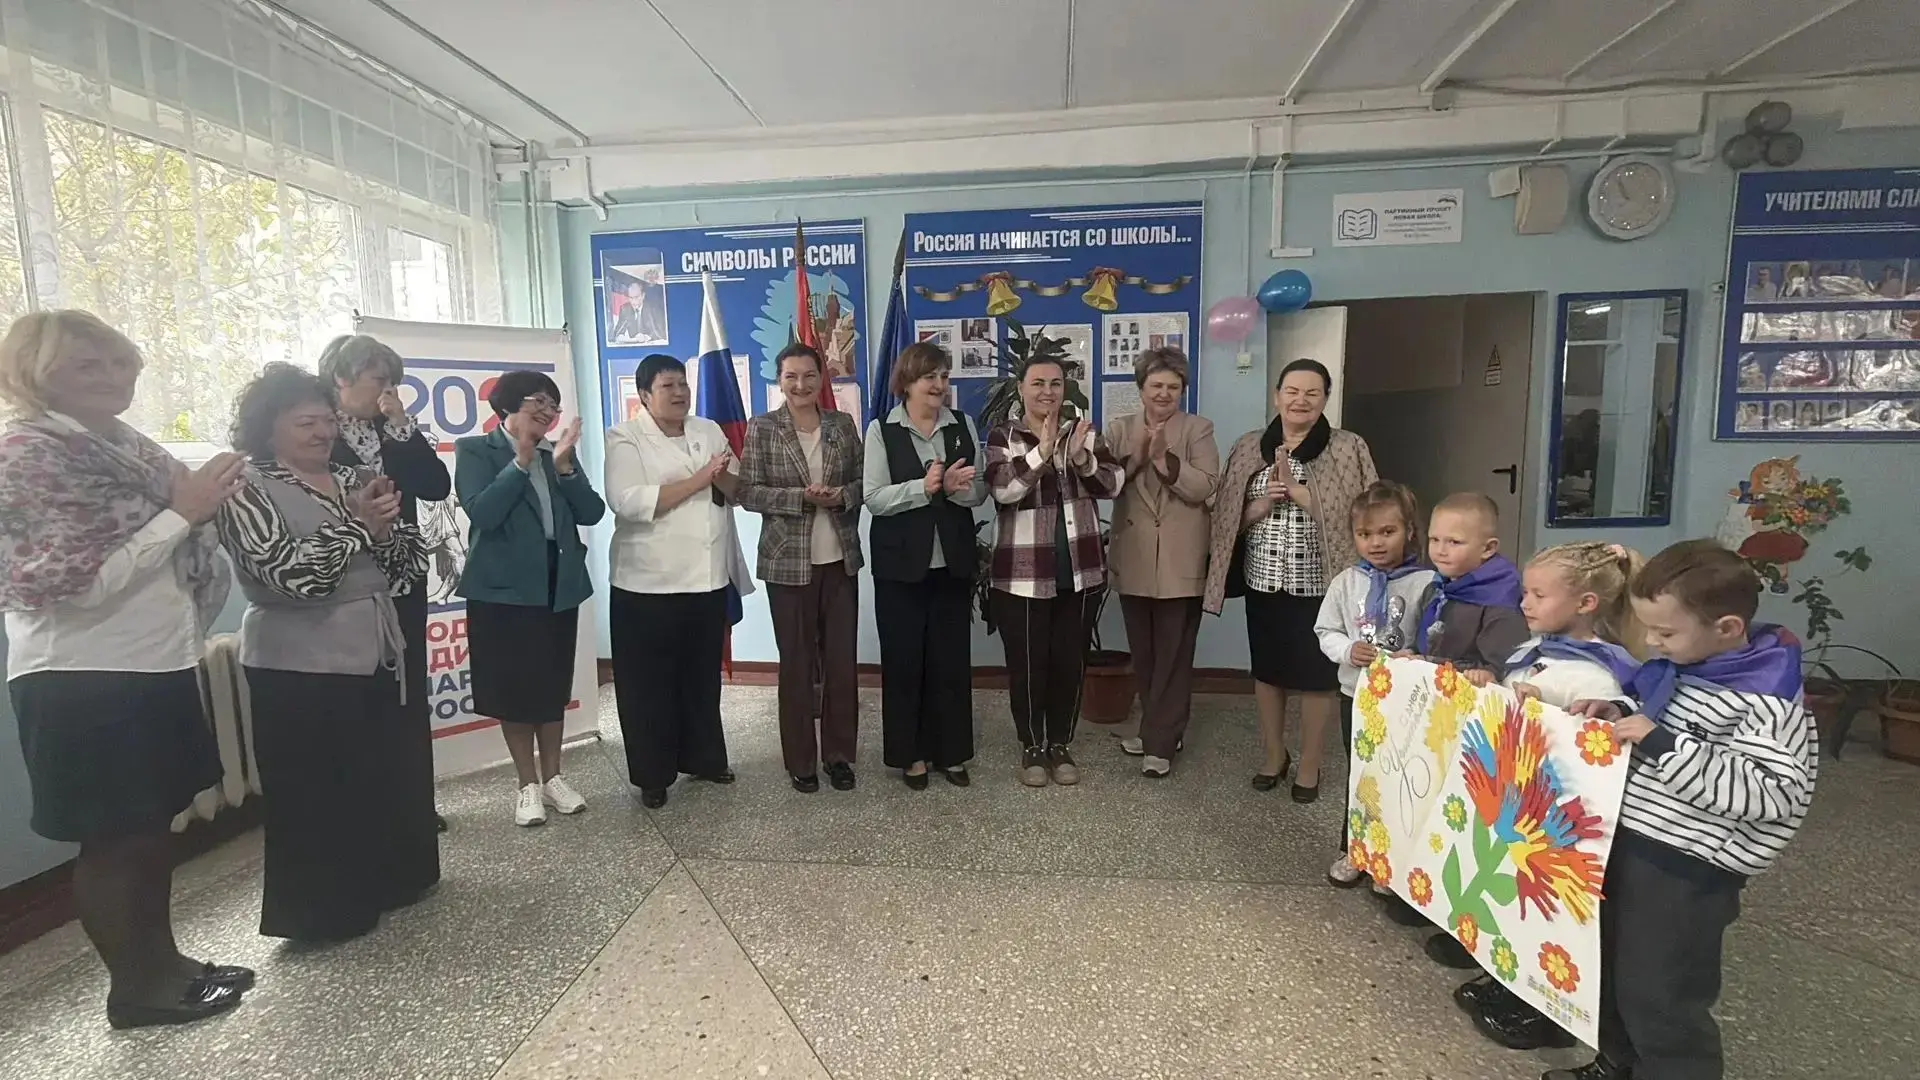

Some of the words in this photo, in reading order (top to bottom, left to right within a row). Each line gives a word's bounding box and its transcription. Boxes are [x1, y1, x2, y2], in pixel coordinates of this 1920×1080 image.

[1765, 189, 1882, 212] УЧИТЕЛЯМИ
[980, 229, 1080, 250] НАЧИНАЕТСЯ
[1085, 227, 1107, 247] СО
[1111, 225, 1192, 245] ШКОЛЫ...
[681, 247, 777, 273] СИМВОЛЫ
[782, 243, 856, 268] РССИИ
